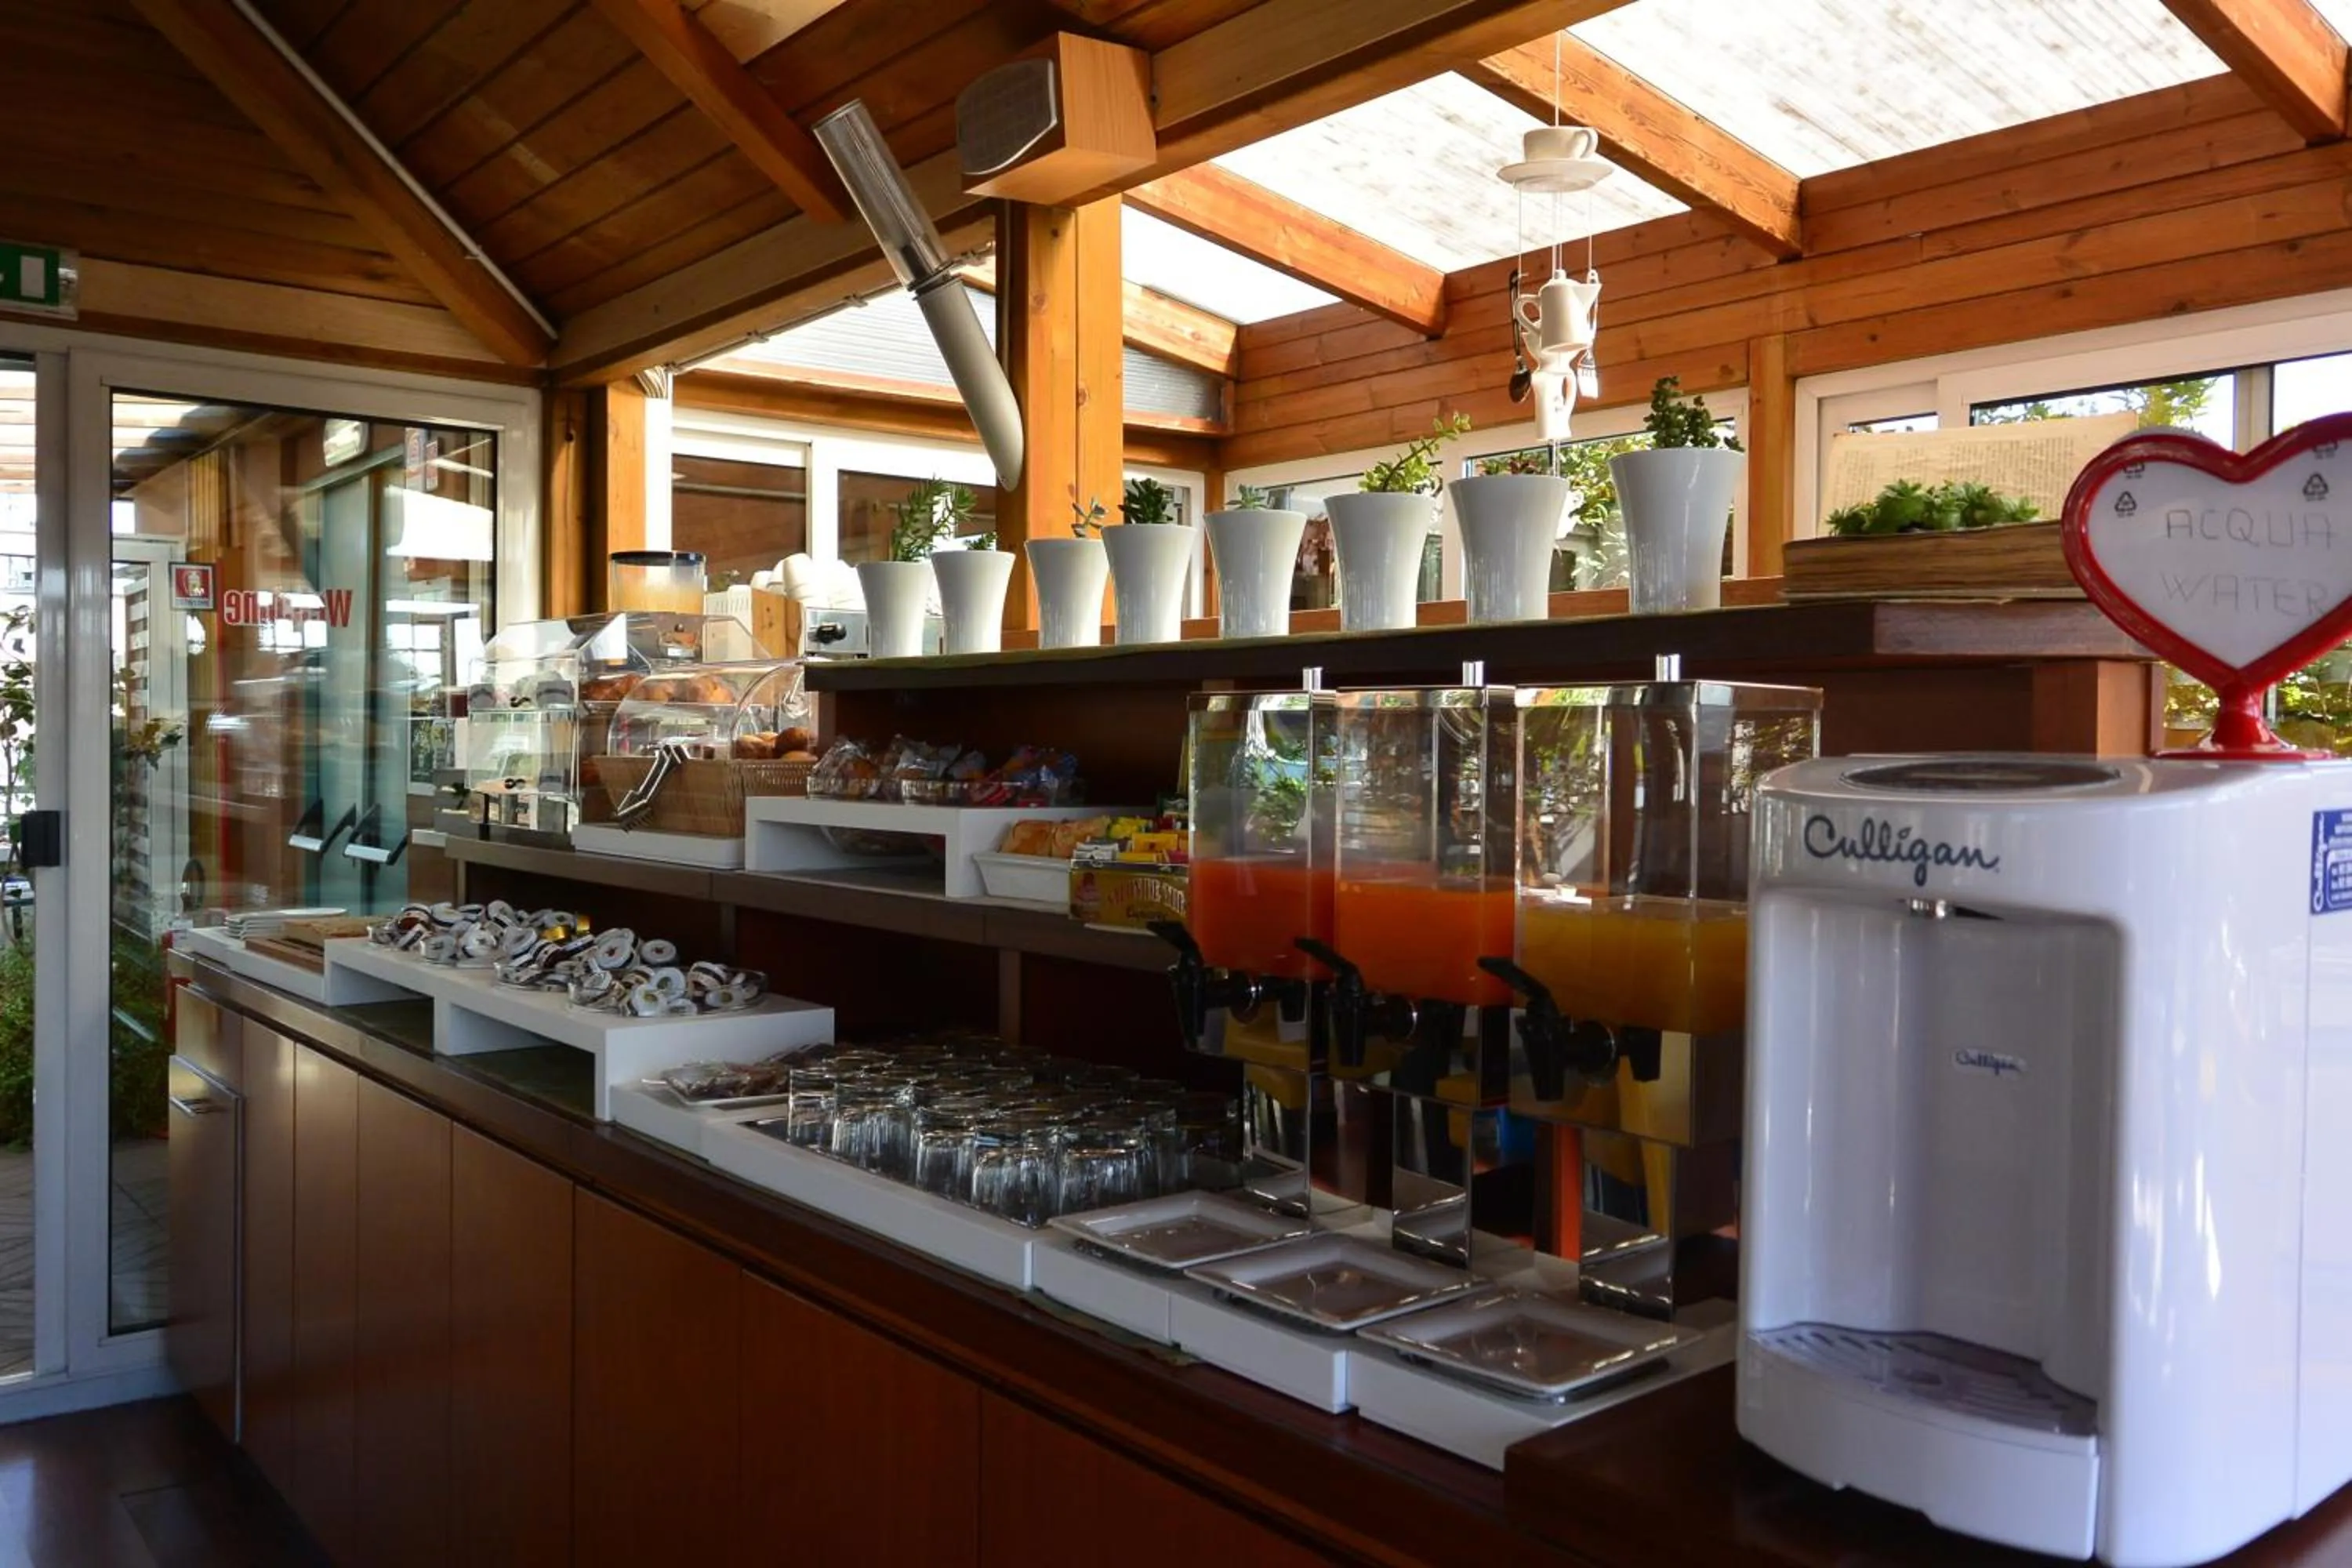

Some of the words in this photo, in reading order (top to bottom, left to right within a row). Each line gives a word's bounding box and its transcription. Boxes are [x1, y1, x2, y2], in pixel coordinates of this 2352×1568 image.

[2166, 507, 2335, 550] ACQUA
[2160, 571, 2330, 617] WATER
[1803, 814, 2002, 887] Culligan
